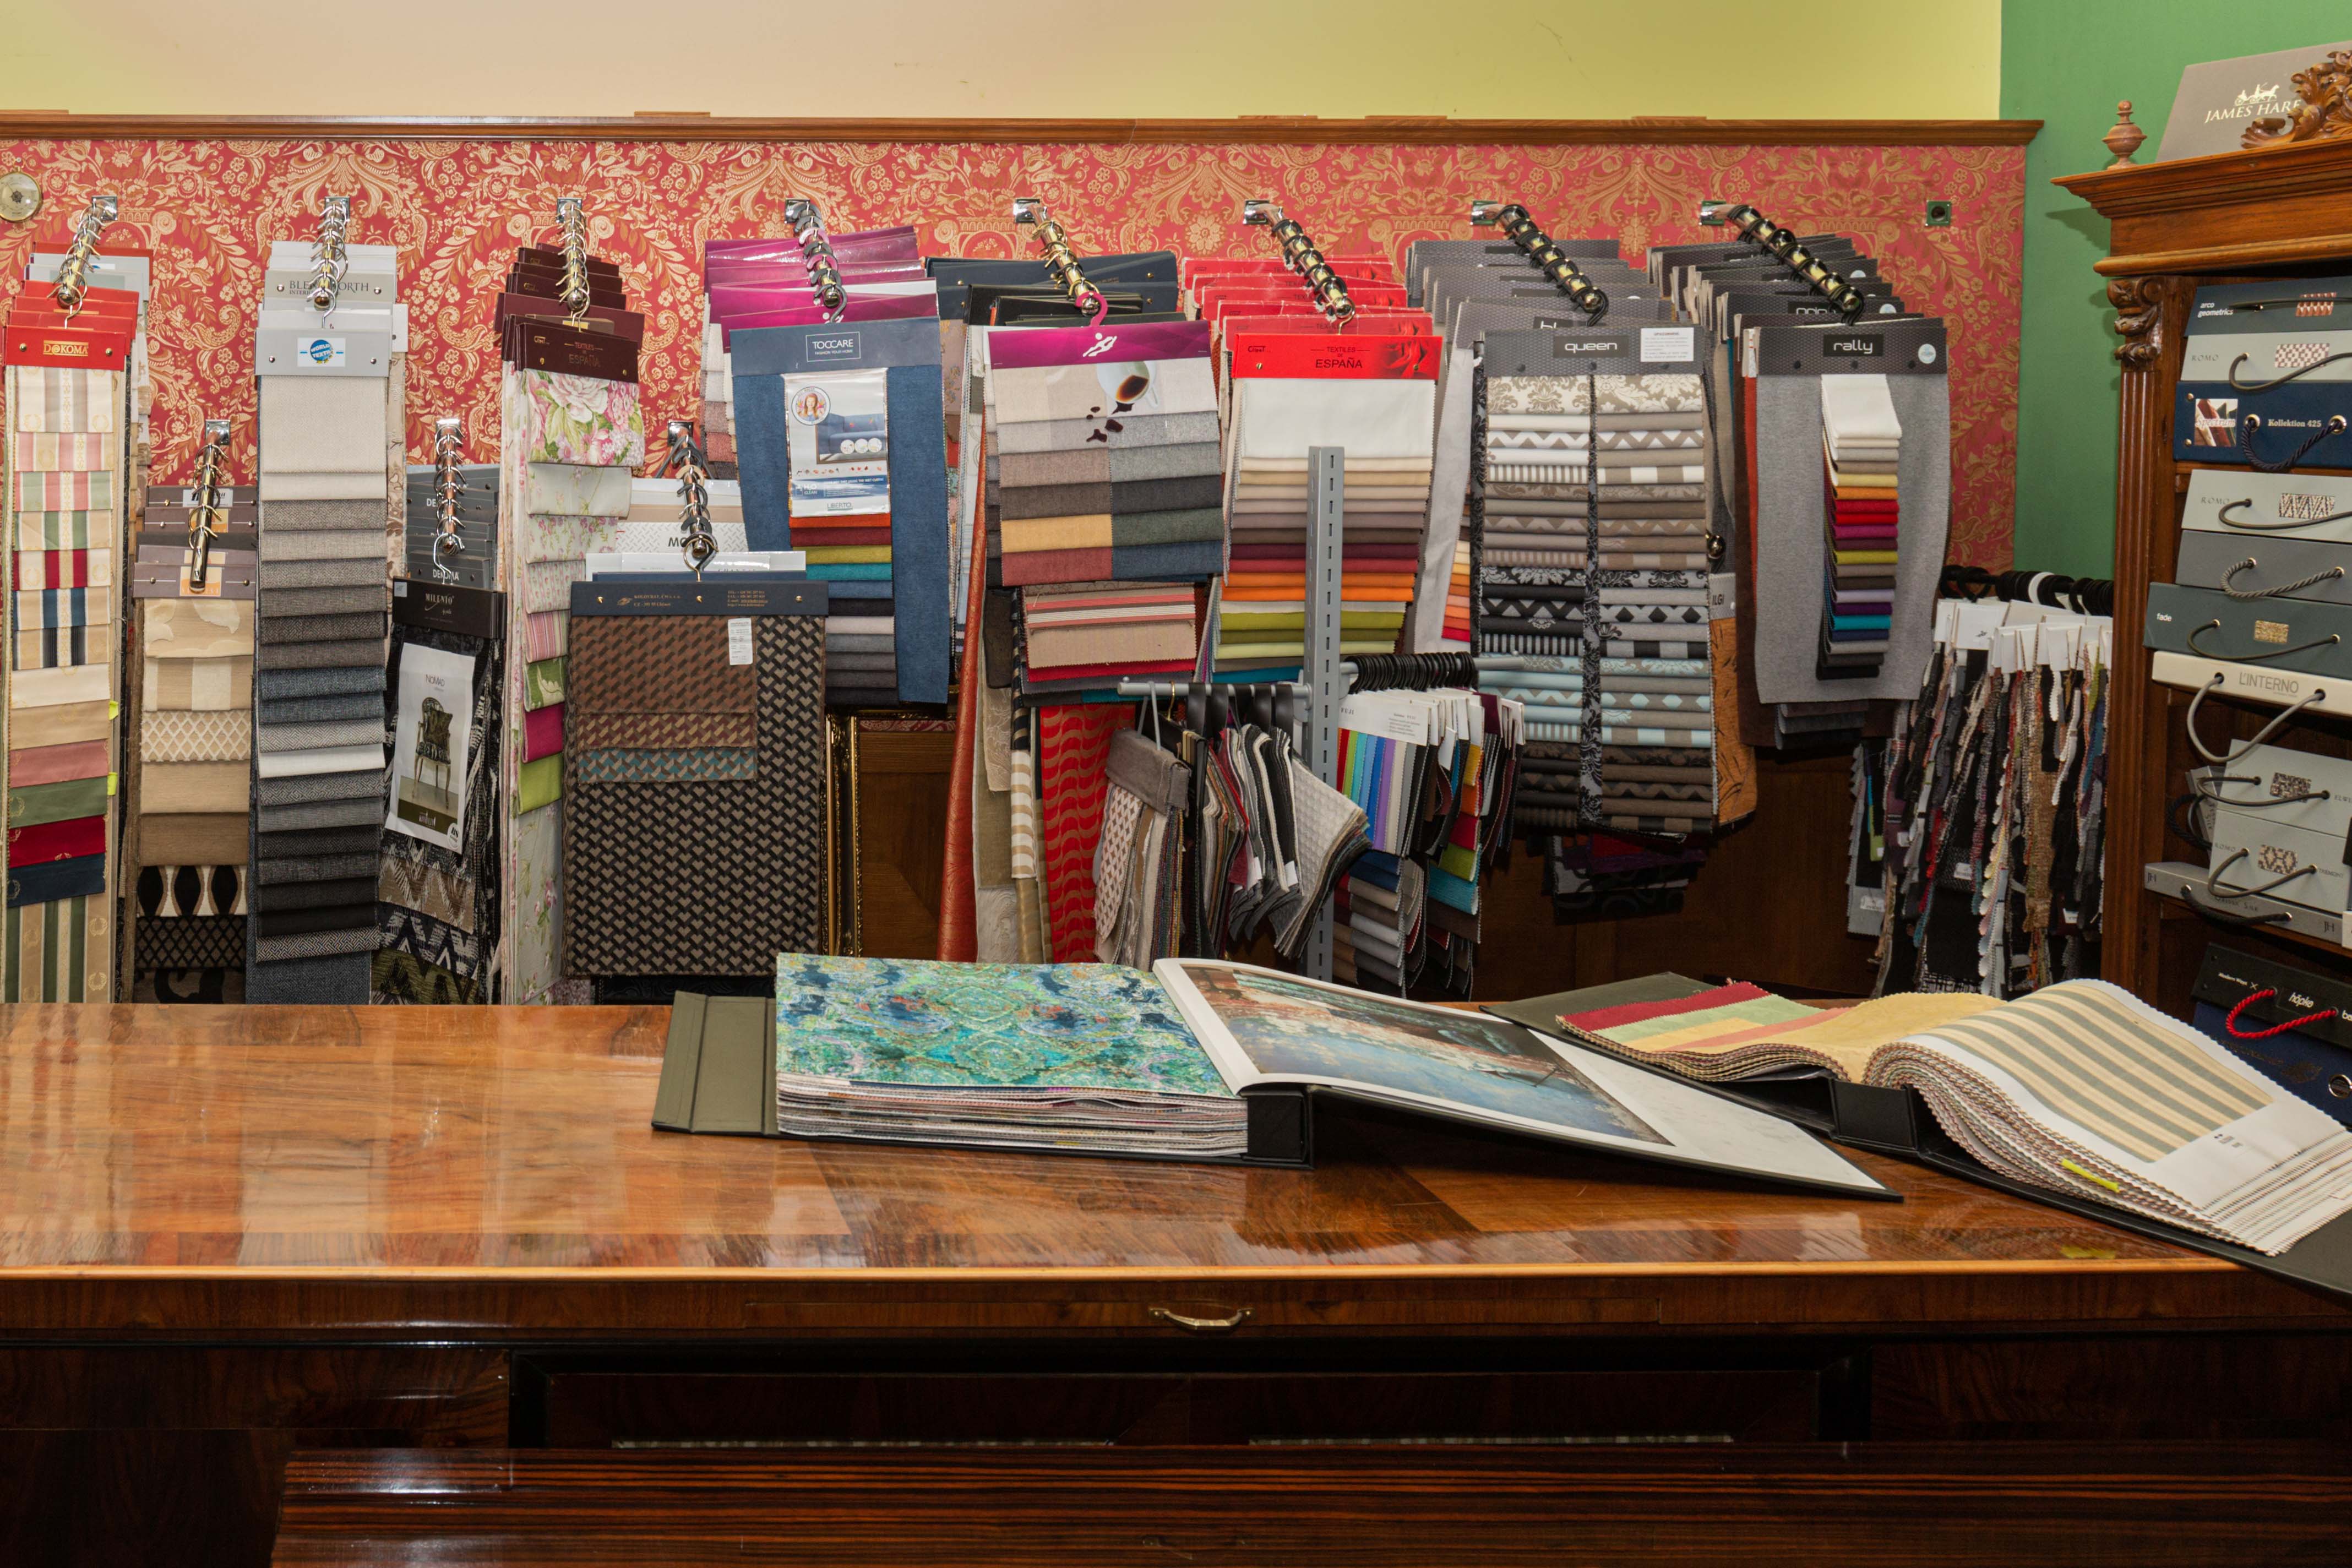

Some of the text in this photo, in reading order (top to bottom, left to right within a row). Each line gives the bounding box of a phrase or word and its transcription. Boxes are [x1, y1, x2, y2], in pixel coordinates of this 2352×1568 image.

[2204, 105, 2253, 124] JAMES
[2197, 308, 2234, 318] geometrics
[812, 339, 854, 350] TOCCARE
[1564, 342, 1618, 354] queen
[1833, 339, 1873, 354] rally
[1315, 357, 1363, 368] ESPAÑA
[2195, 417, 2236, 431] Spectrum
[2268, 419, 2322, 428] Kollektion 425
[2157, 612, 2172, 622] fade
